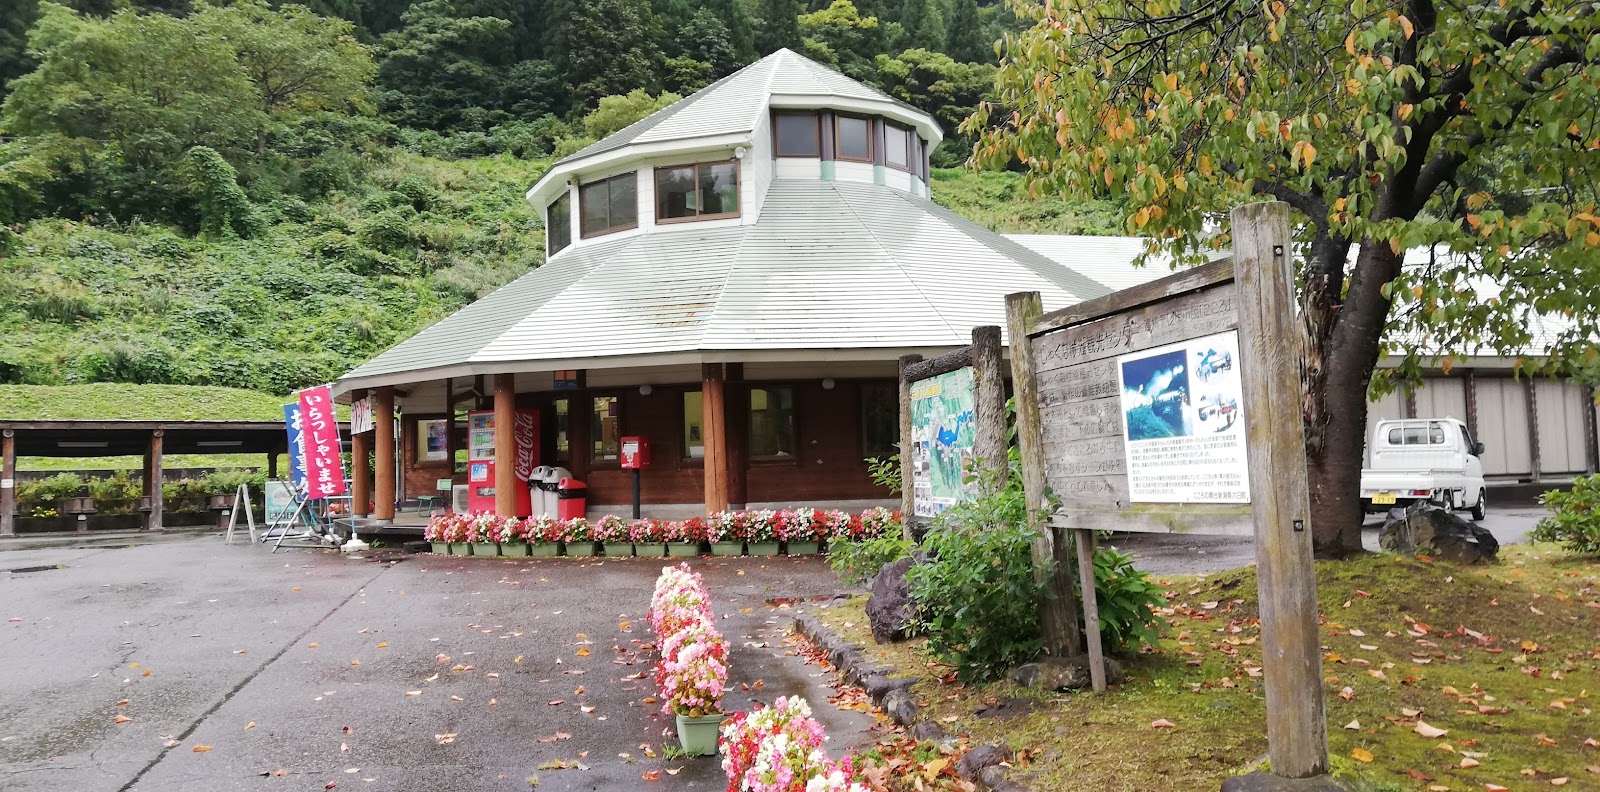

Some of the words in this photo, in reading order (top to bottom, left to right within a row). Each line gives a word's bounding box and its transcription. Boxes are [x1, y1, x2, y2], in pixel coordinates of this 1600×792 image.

[304, 395, 336, 494] いらっしゃいませ
[515, 411, 534, 482] Coca-Cola
